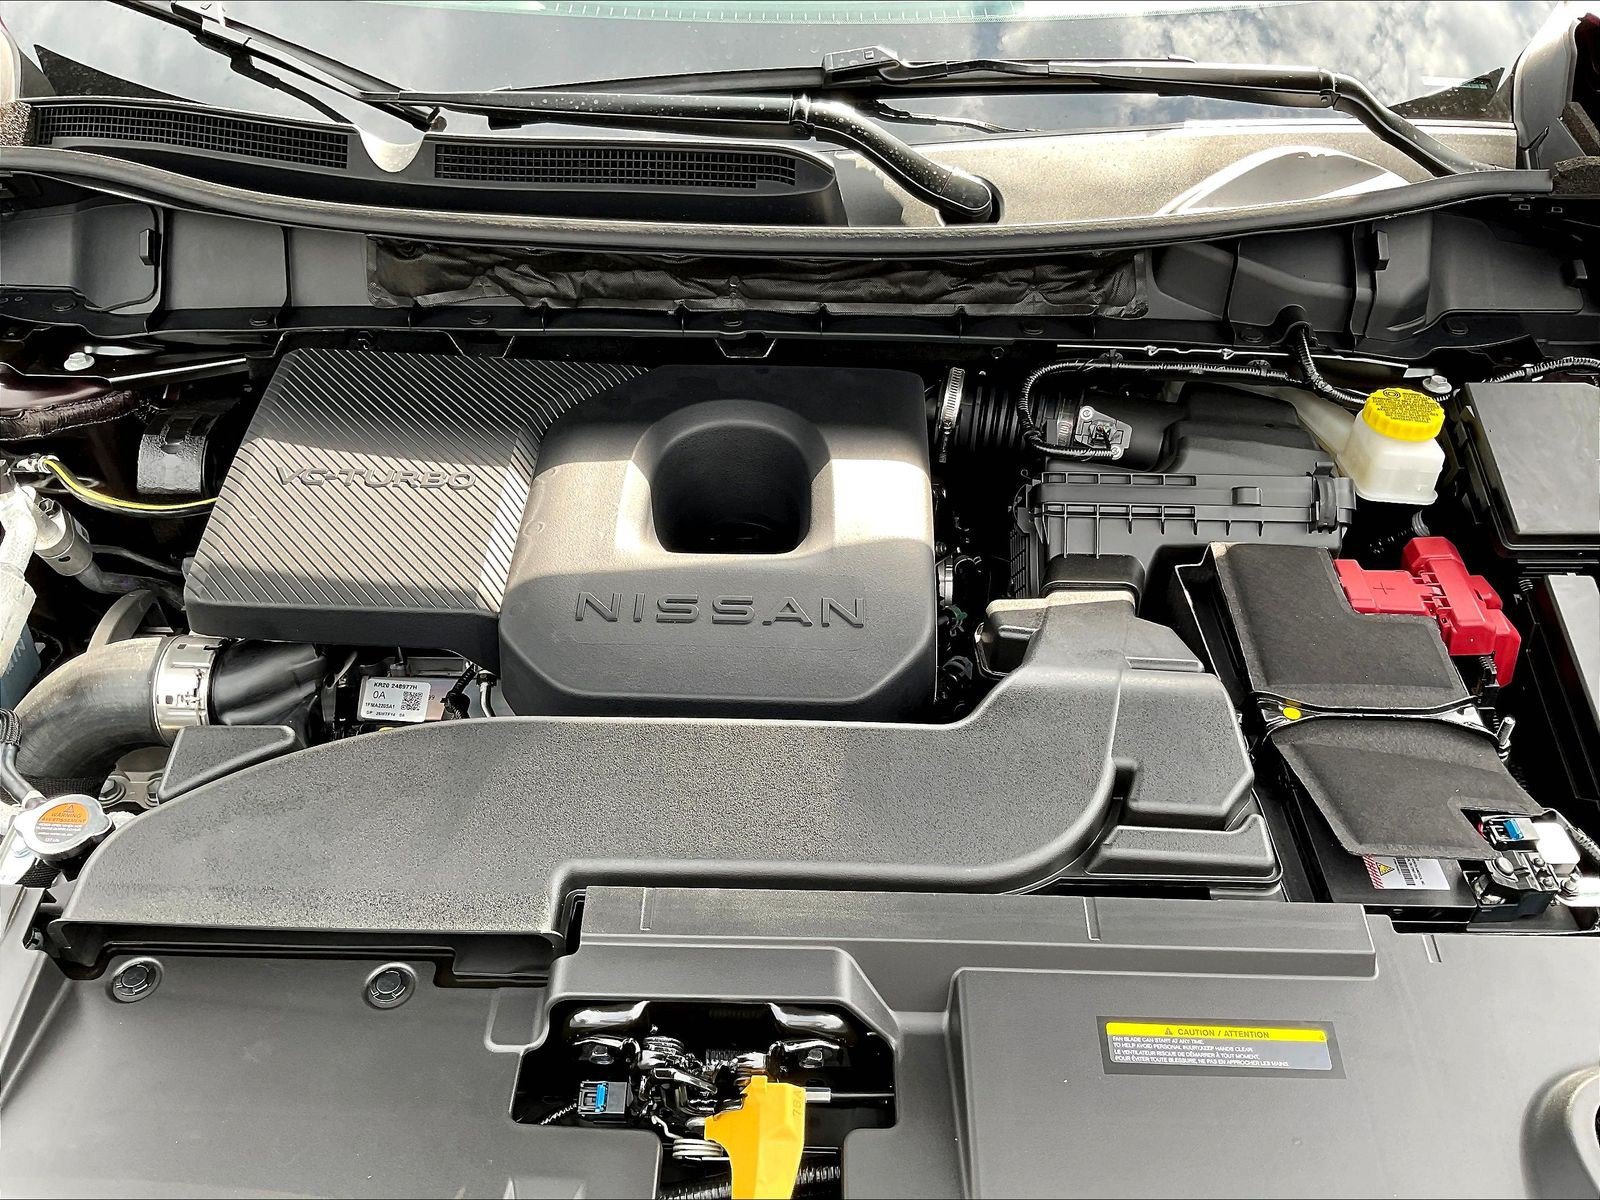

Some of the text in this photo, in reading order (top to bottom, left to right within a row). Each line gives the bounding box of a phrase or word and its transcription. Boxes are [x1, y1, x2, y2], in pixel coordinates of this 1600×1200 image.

[276, 466, 476, 491] VC-TURBO
[575, 592, 865, 628] NISSAN
[372, 690, 386, 699] 0A
[1178, 1028, 1215, 1037] CAUTION
[1223, 1030, 1270, 1039] ATTENTION
